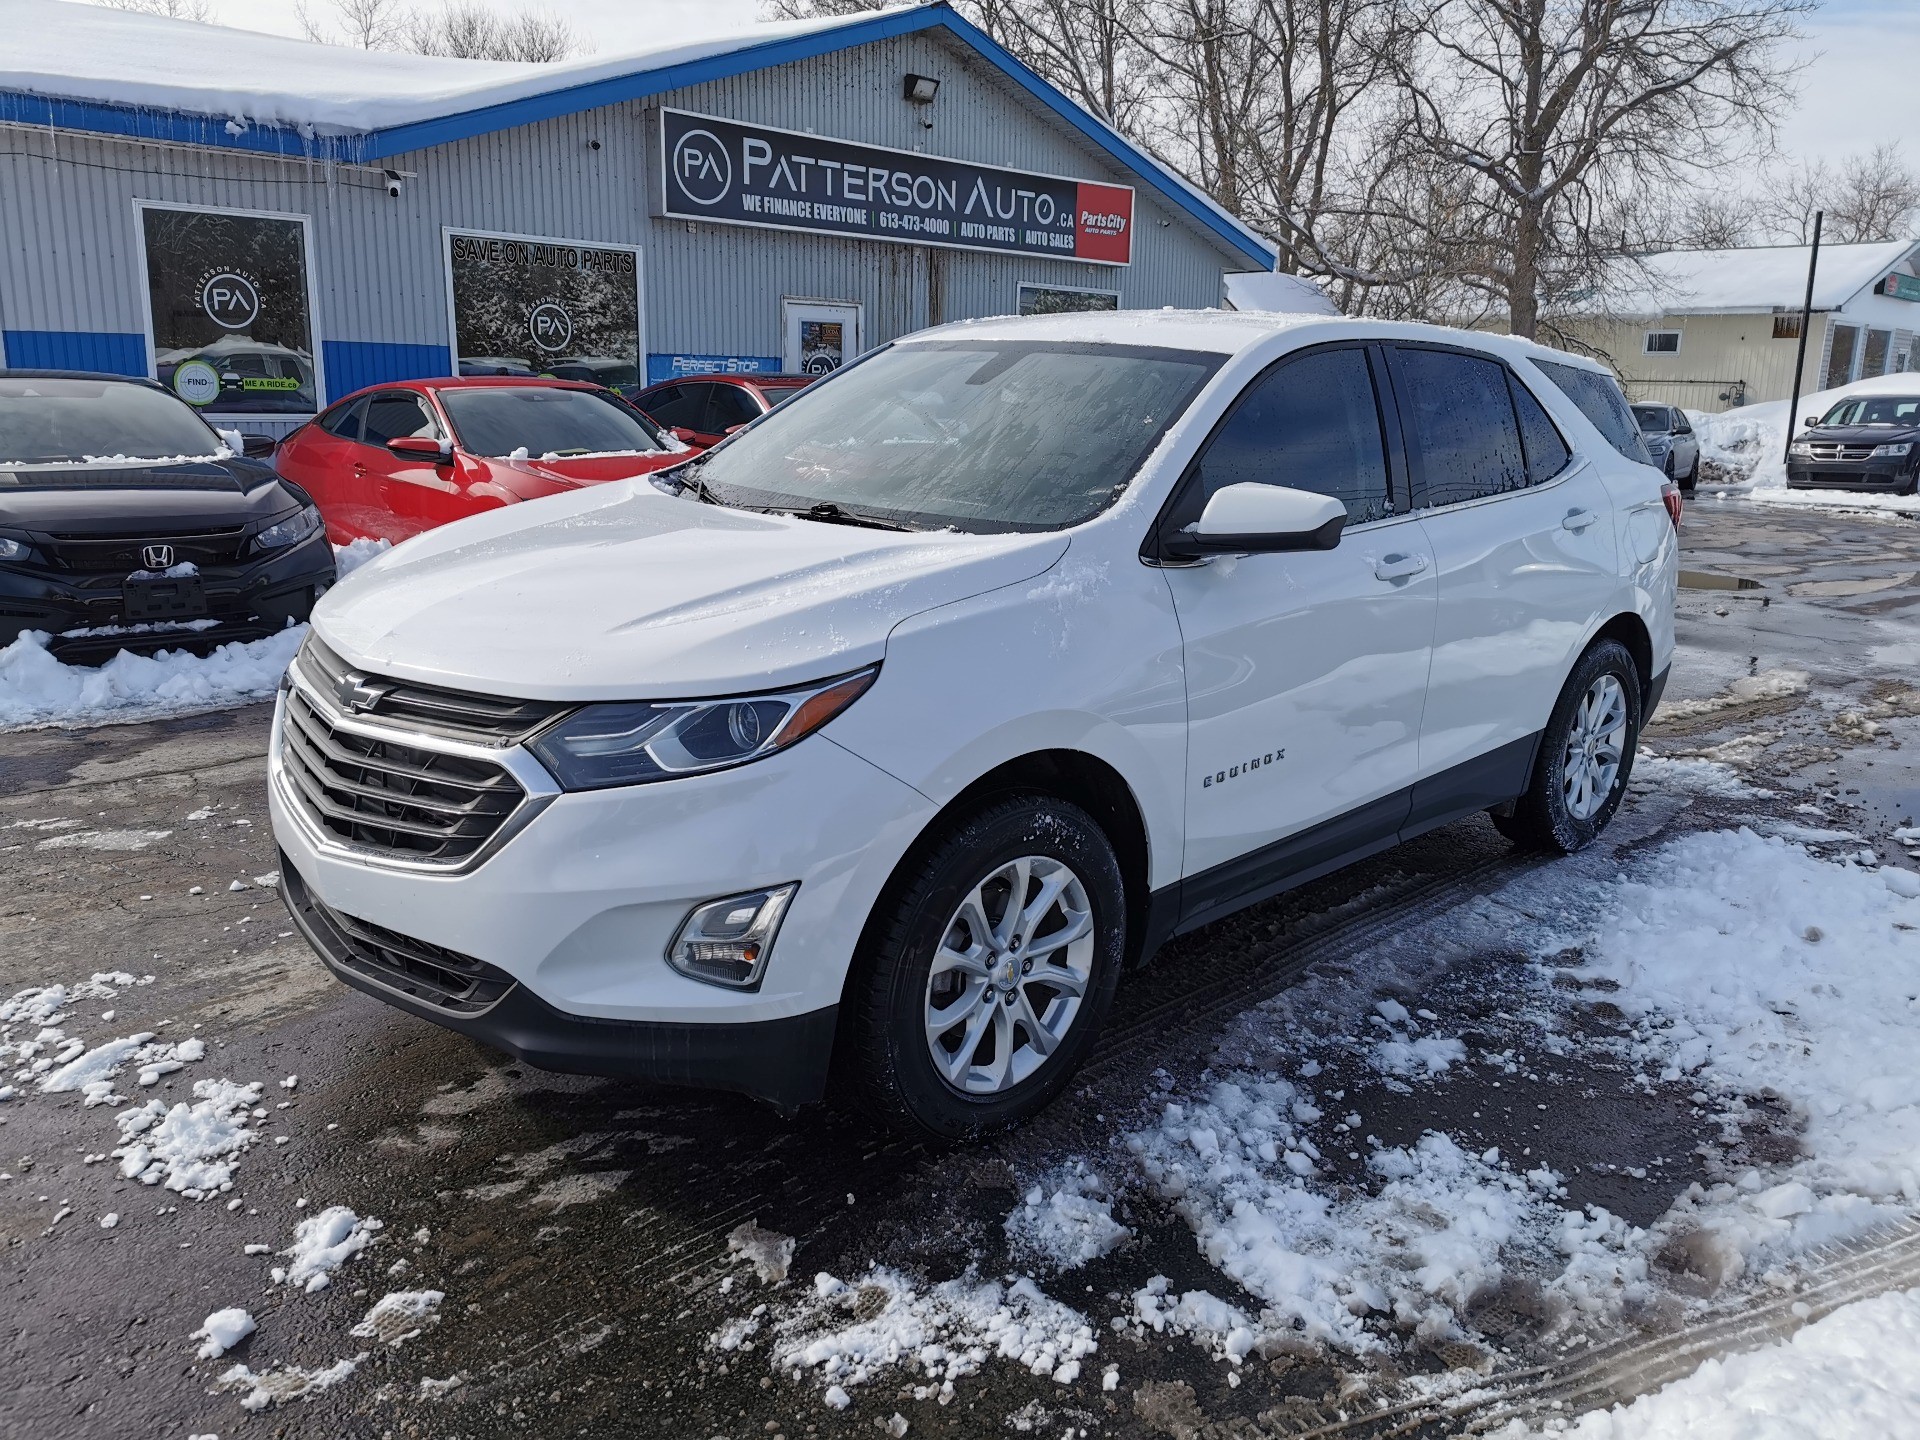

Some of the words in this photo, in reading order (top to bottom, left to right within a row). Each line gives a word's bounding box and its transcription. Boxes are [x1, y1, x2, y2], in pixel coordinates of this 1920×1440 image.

[683, 147, 723, 182] PA
[742, 136, 957, 213] PATTERSON
[741, 193, 762, 213] WE
[763, 196, 812, 219] FINANCE
[813, 202, 867, 225] EVERYONE
[879, 211, 950, 235] 613-473-4000
[960, 221, 985, 239] AUTO
[986, 226, 1016, 243] PARTS
[1025, 229, 1048, 246] AUTO
[1049, 232, 1074, 249] SALES
[453, 237, 500, 262] SAVE
[503, 242, 530, 266] ON
[532, 245, 578, 269] AUTO
[582, 250, 634, 274] PARTS
[195, 265, 230, 308] PATTERSON
[212, 288, 251, 311] PA
[537, 316, 566, 336] PA
[187, 378, 208, 386] FIND
[1203, 748, 1286, 788] EQUINOX
